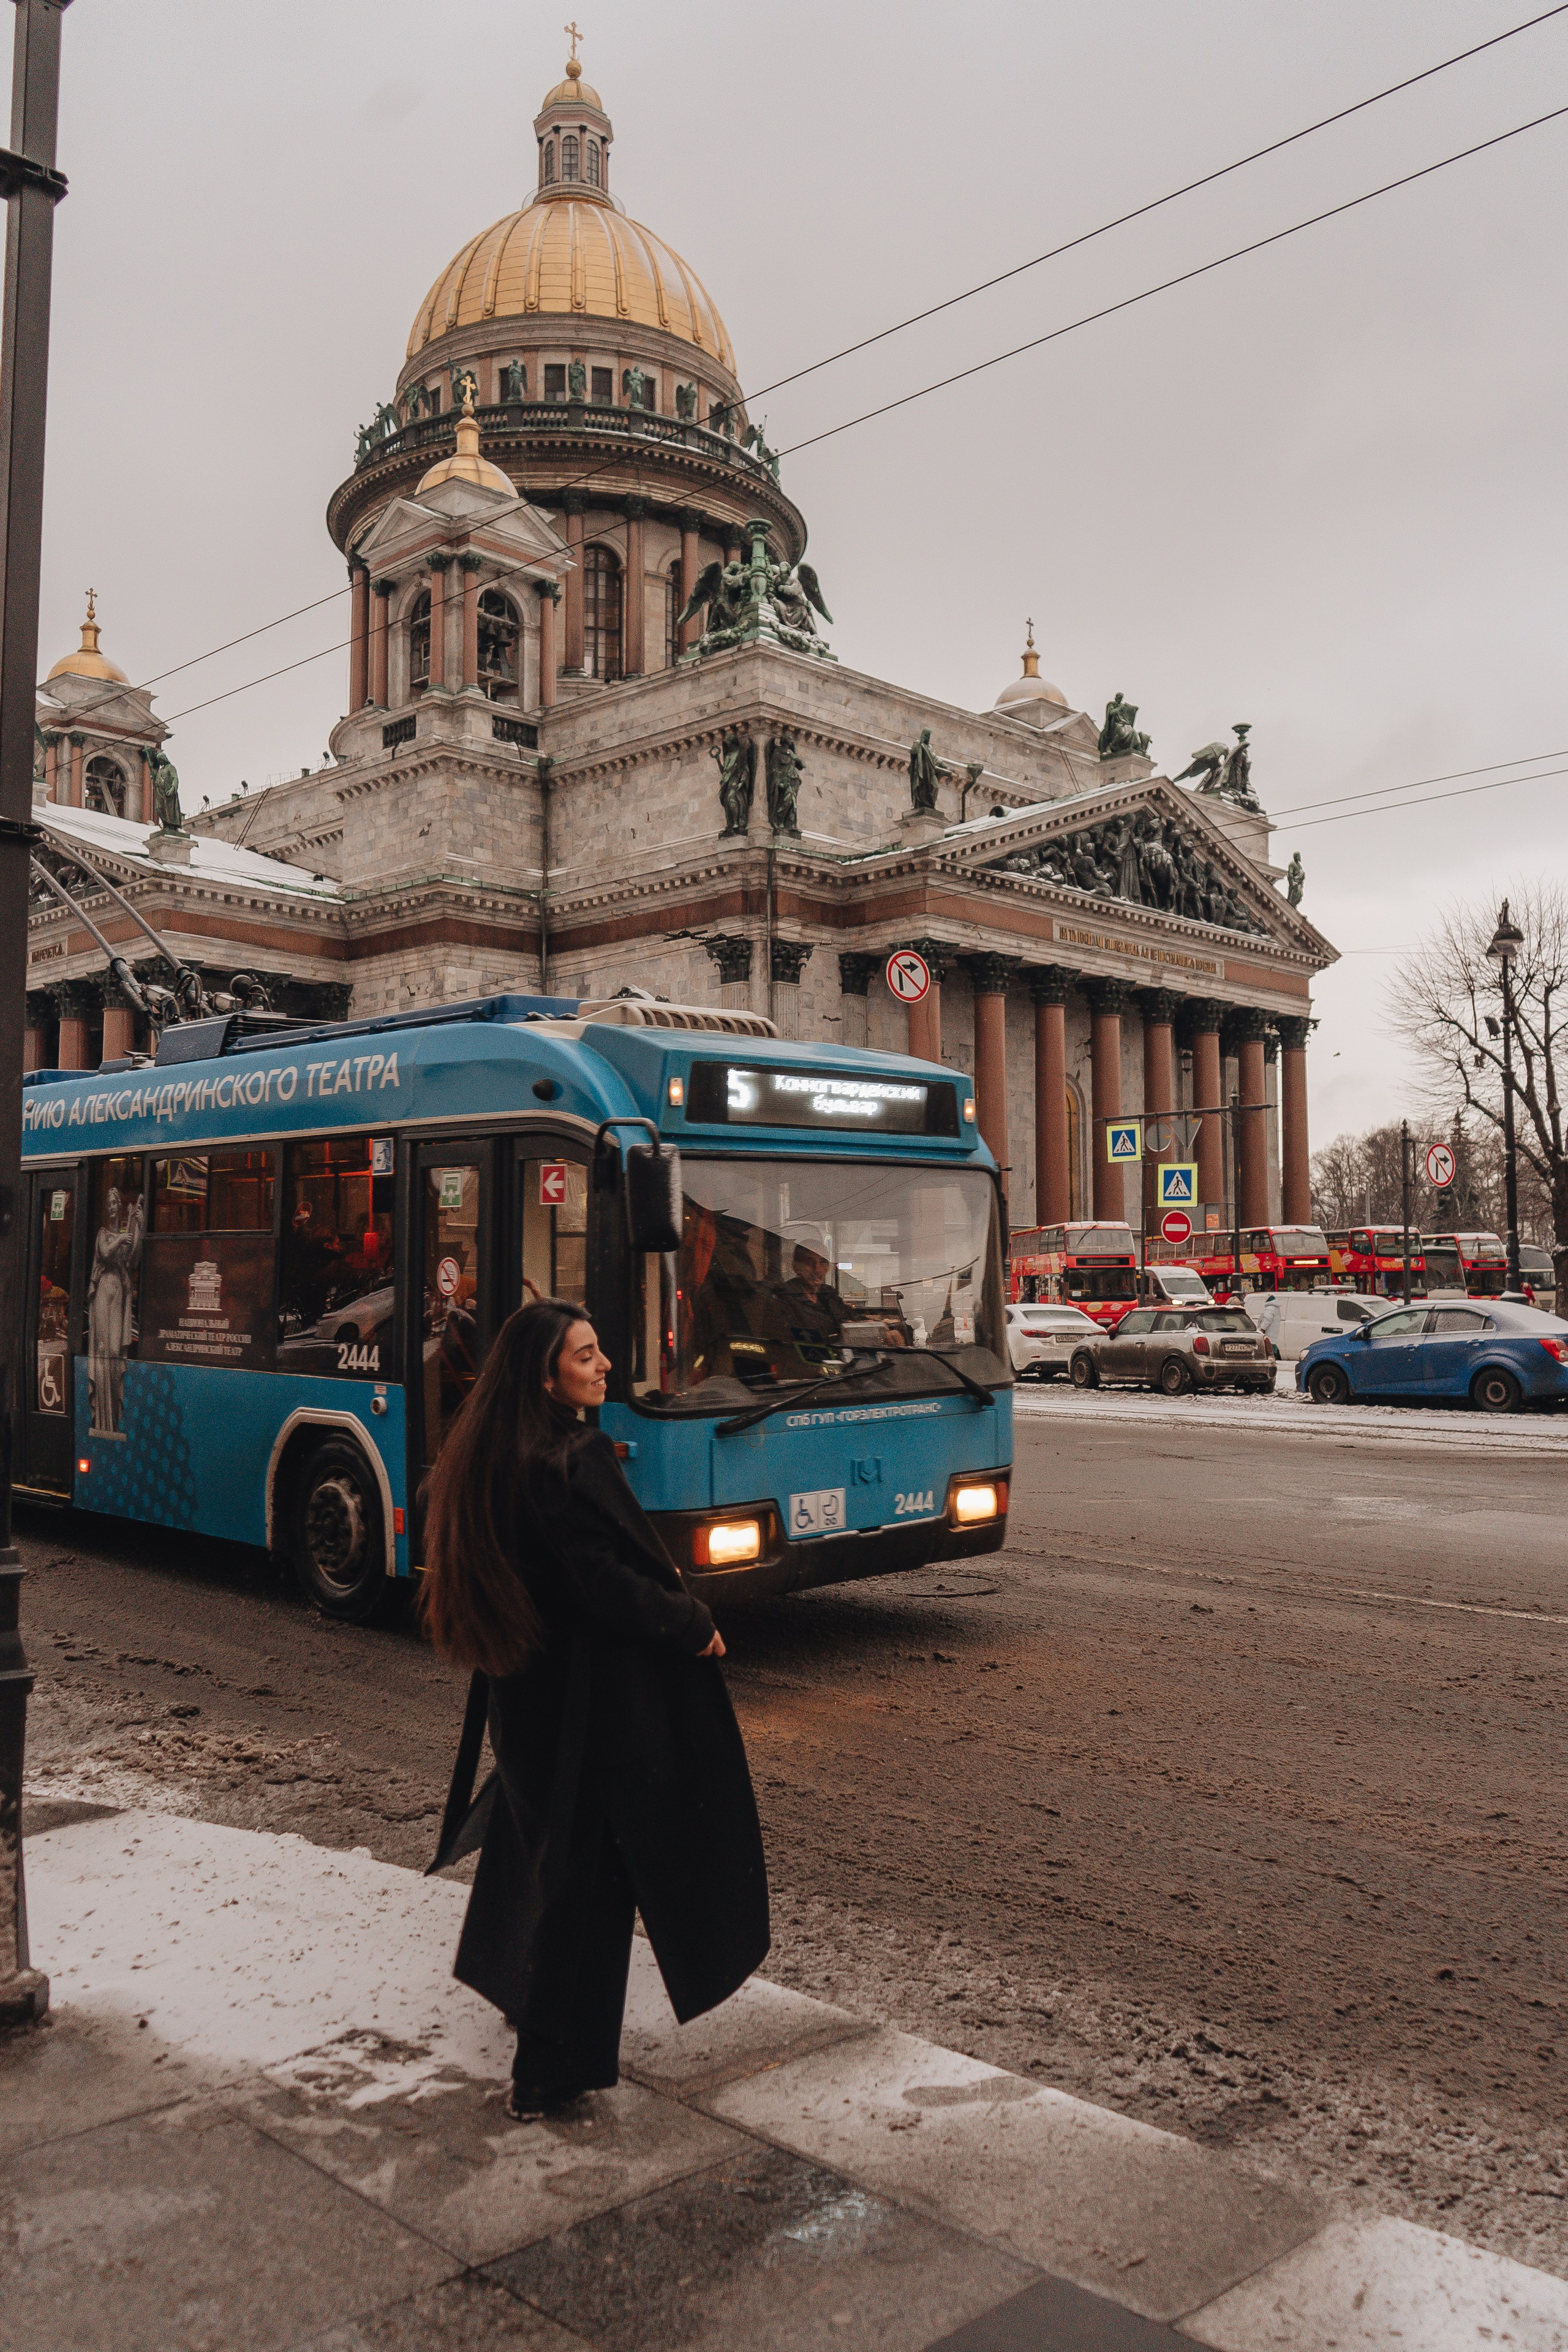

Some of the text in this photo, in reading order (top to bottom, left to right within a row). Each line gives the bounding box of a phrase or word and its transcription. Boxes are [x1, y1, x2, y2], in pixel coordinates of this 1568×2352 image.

[22, 1052, 401, 1131] НИЮ АЛЕКСАНДРИНСКОГО ТЕАТРА
[727, 1068, 752, 1108] 5
[337, 1343, 380, 1371] 2444
[811, 1412, 834, 1424] ГУП
[894, 1490, 934, 1515] 2444
